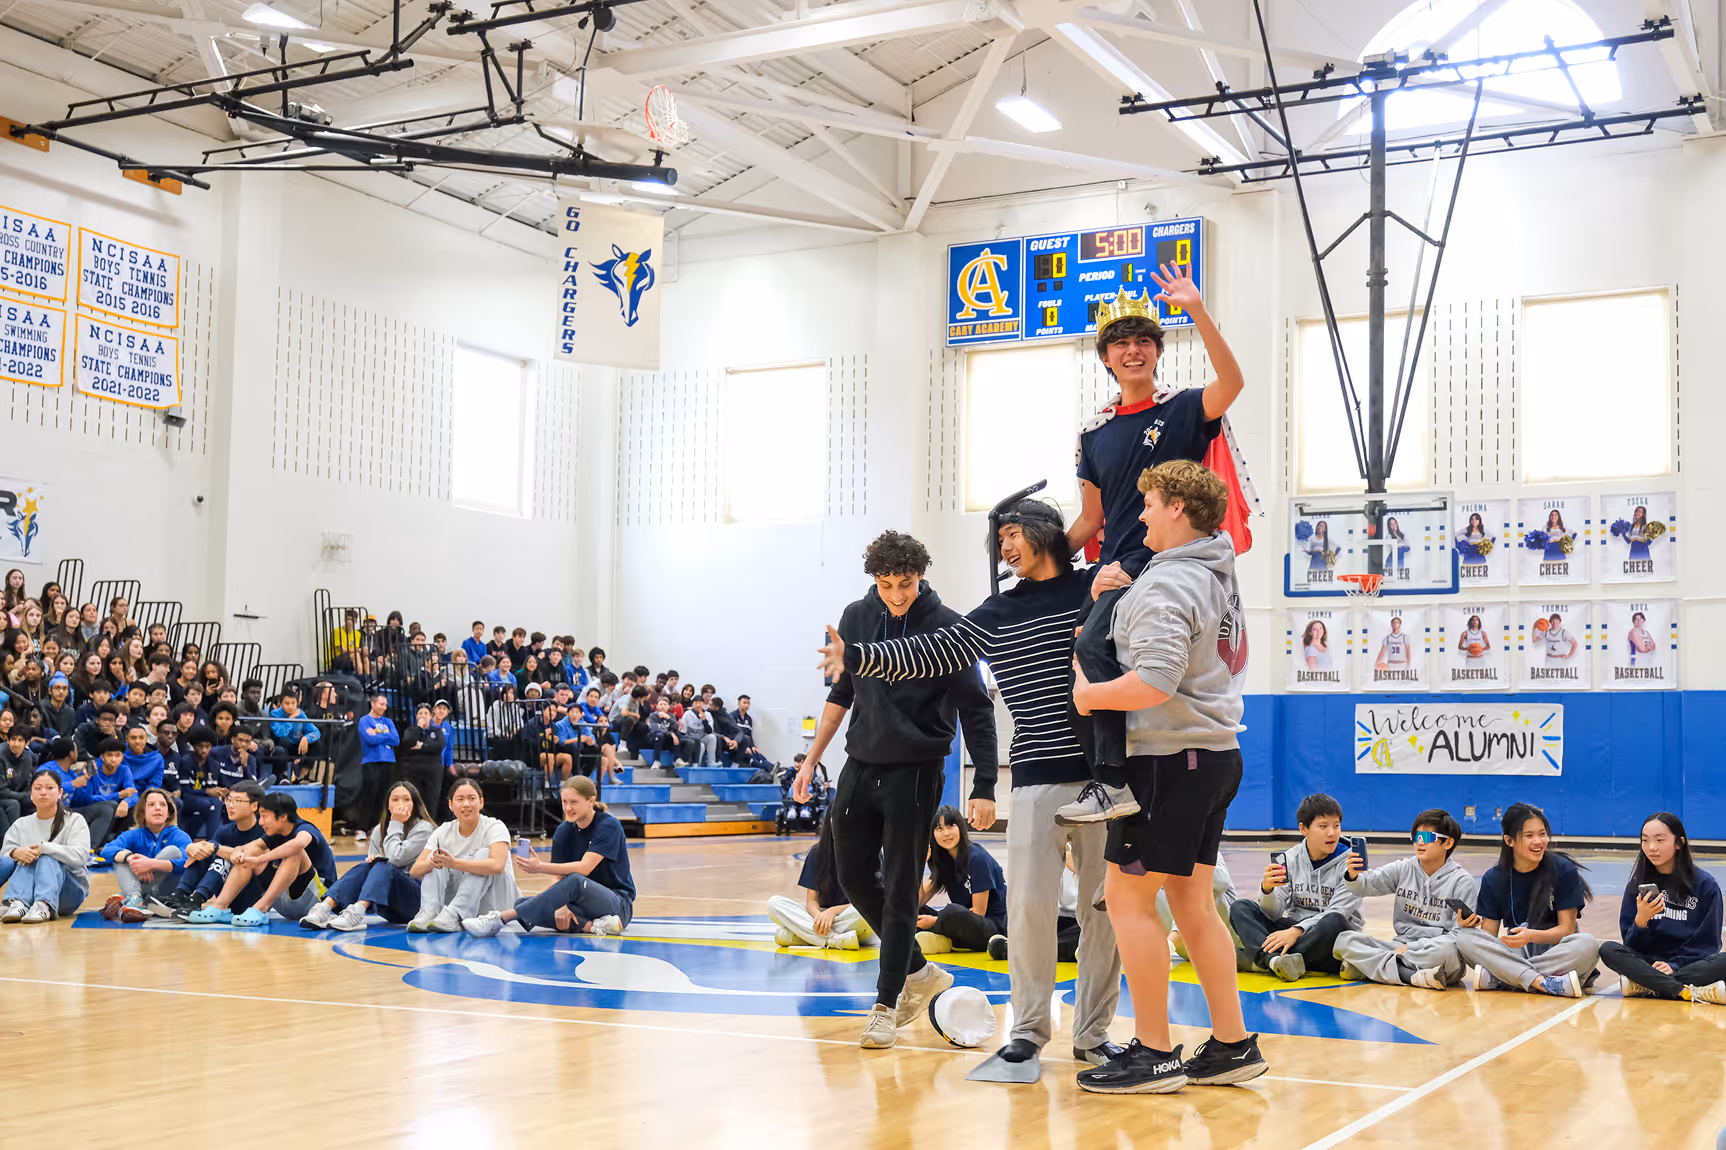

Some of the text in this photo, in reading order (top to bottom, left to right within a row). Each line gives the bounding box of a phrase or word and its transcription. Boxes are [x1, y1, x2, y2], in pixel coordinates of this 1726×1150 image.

[1152, 222, 1195, 238] CHARGERS
[25, 239, 64, 259] COUNTRY
[1030, 236, 1070, 251] GUEST
[1095, 228, 1142, 257] 5:00
[92, 237, 167, 273] NCISAA
[4, 249, 64, 276] CHAMPIONS
[94, 255, 166, 288] BOYS TENNIS
[1078, 270, 1115, 282] PERIOD
[83, 268, 174, 306] STATE CHAMPIONS
[561, 206, 581, 354] GO CHARGERS
[1084, 290, 1138, 302] PLAYER-OUL
[96, 290, 160, 319] 2015 2016
[1038, 299, 1062, 308] FOULS
[1159, 316, 1188, 325] POINTS
[4, 324, 48, 344] SWIMMING
[950, 321, 1018, 336] CARY ACADEMY
[1036, 327, 1063, 336] POINTS
[90, 324, 164, 354] NCISAA
[98, 344, 156, 368] BOYS TENNIS
[82, 355, 172, 387] STATE CHAMPIONS
[92, 376, 160, 402] 2021-2022
[1462, 504, 1488, 512] PALOMA
[1544, 500, 1564, 510] SARAH
[1627, 497, 1648, 506] TSEGA
[1460, 565, 1488, 578] CHEER
[1540, 562, 1569, 576] CHEER
[1623, 560, 1654, 574] CHEER
[1307, 570, 1334, 582] CHEER
[1308, 611, 1332, 619] CARMEN
[1542, 604, 1568, 612] THOMAS
[1630, 604, 1648, 612] NOVA
[1297, 670, 1340, 682] BASKETBALL
[1374, 668, 1418, 682] BASKETBALL
[1452, 668, 1498, 681] BASKETBALL
[1531, 666, 1578, 680] BASKETBALL
[1614, 666, 1664, 680] BASKETBALL
[1368, 706, 1503, 735] Welcome
[1428, 730, 1534, 763] ALUMNI
[1396, 888, 1419, 900] CARY
[1152, 1059, 1181, 1075] HOKA
